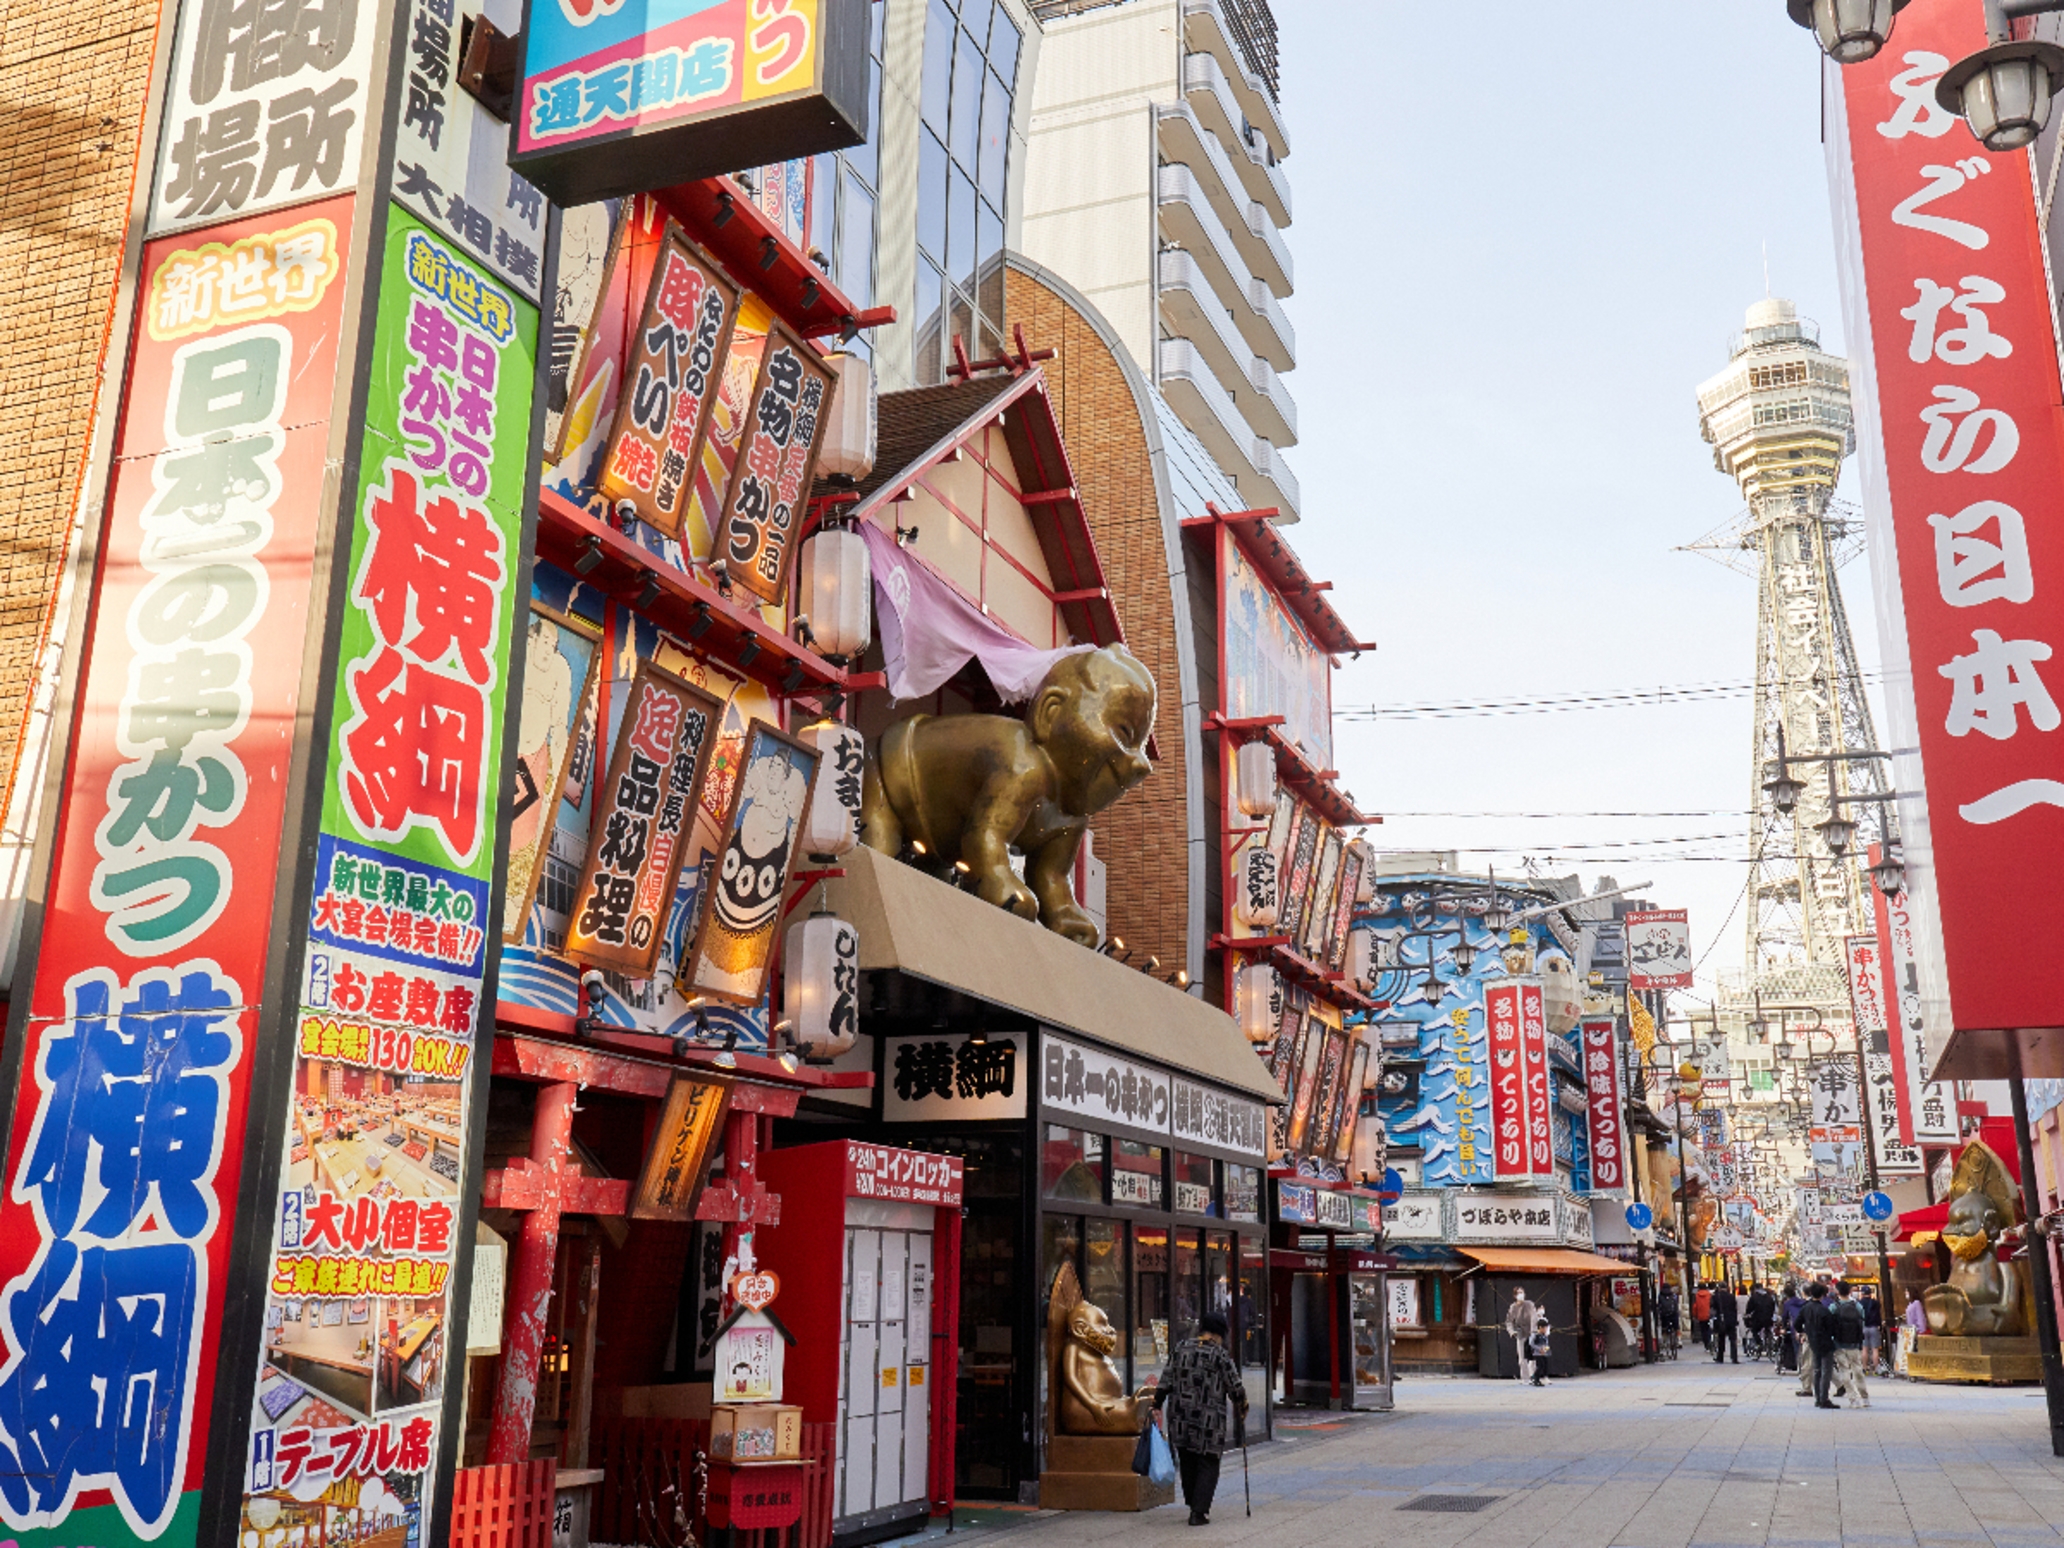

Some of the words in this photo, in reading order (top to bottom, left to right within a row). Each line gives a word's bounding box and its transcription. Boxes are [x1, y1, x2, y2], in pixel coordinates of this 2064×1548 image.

[752, 0, 806, 79] つ
[535, 43, 730, 135] 通天閣店
[165, 78, 359, 219] 場所
[394, 159, 539, 290] 大相撲
[160, 233, 329, 328] 新世界
[411, 238, 512, 336] 新世界
[404, 301, 458, 470] 串かつ
[449, 335, 497, 495] 日本一の
[657, 287, 725, 513] なにわの鉄板焼き
[729, 347, 803, 563] 名物串かつ
[101, 335, 281, 942] 日本一の串かつ
[346, 468, 503, 858] 横綱
[578, 683, 681, 948] 逸品料理
[631, 709, 707, 949] 料理長自慢の
[333, 856, 474, 922] 新世界最大の
[309, 956, 329, 1006] 2階
[331, 962, 474, 1034] お座敷席
[1494, 996, 1515, 1042] 名物
[1524, 996, 1542, 1040] 名物
[1853, 947, 1877, 1000] 串かつ
[895, 1039, 1017, 1100] 横綱
[1045, 1043, 1169, 1126] 日本一の串かつ
[1451, 1007, 1477, 1177] 安うて何んでも旨い
[1818, 1069, 1850, 1128] 串か
[1498, 1072, 1520, 1166] てっちり
[1528, 1073, 1549, 1165] てっちり
[1588, 1050, 1618, 1184] 珍味てっちり
[876, 1149, 962, 1188] コインロッカー
[0, 972, 232, 1524] 横綱
[283, 1192, 300, 1247] 2階
[302, 1193, 453, 1251] 大小個室
[1461, 1206, 1551, 1227] づぼらや本店
[271, 1259, 448, 1295] ご家族連れに最適!!
[275, 1417, 433, 1485] テーブル席
